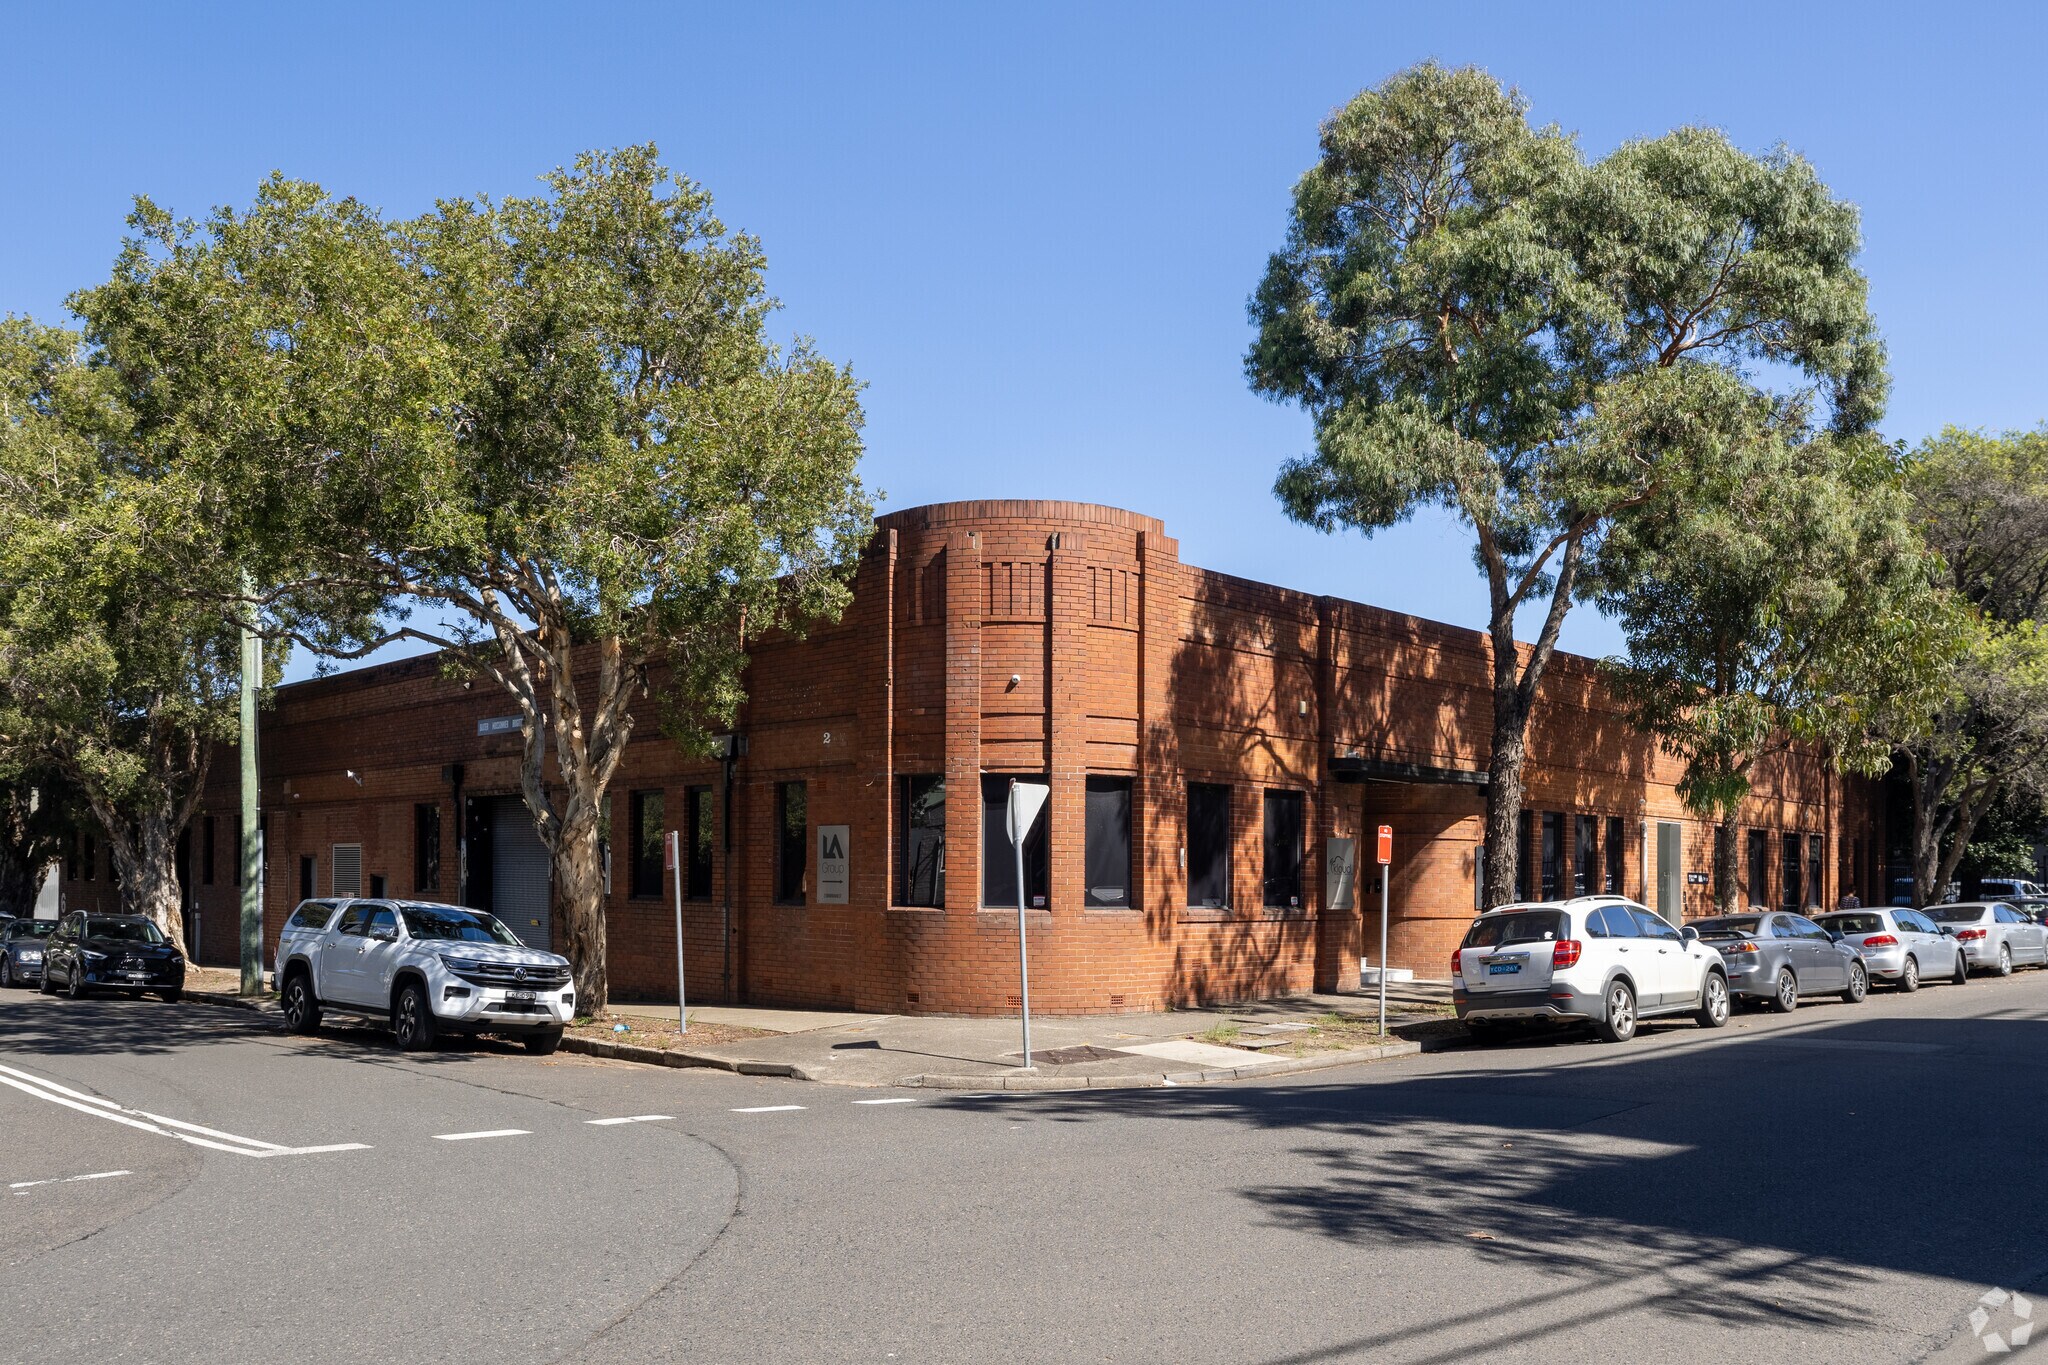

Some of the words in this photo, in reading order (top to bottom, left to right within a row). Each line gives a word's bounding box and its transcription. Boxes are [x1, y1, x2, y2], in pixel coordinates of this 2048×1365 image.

[823, 732, 831, 744] 2
[823, 834, 844, 859] LA
[822, 862, 844, 876] Group
[61, 893, 67, 914] 6
